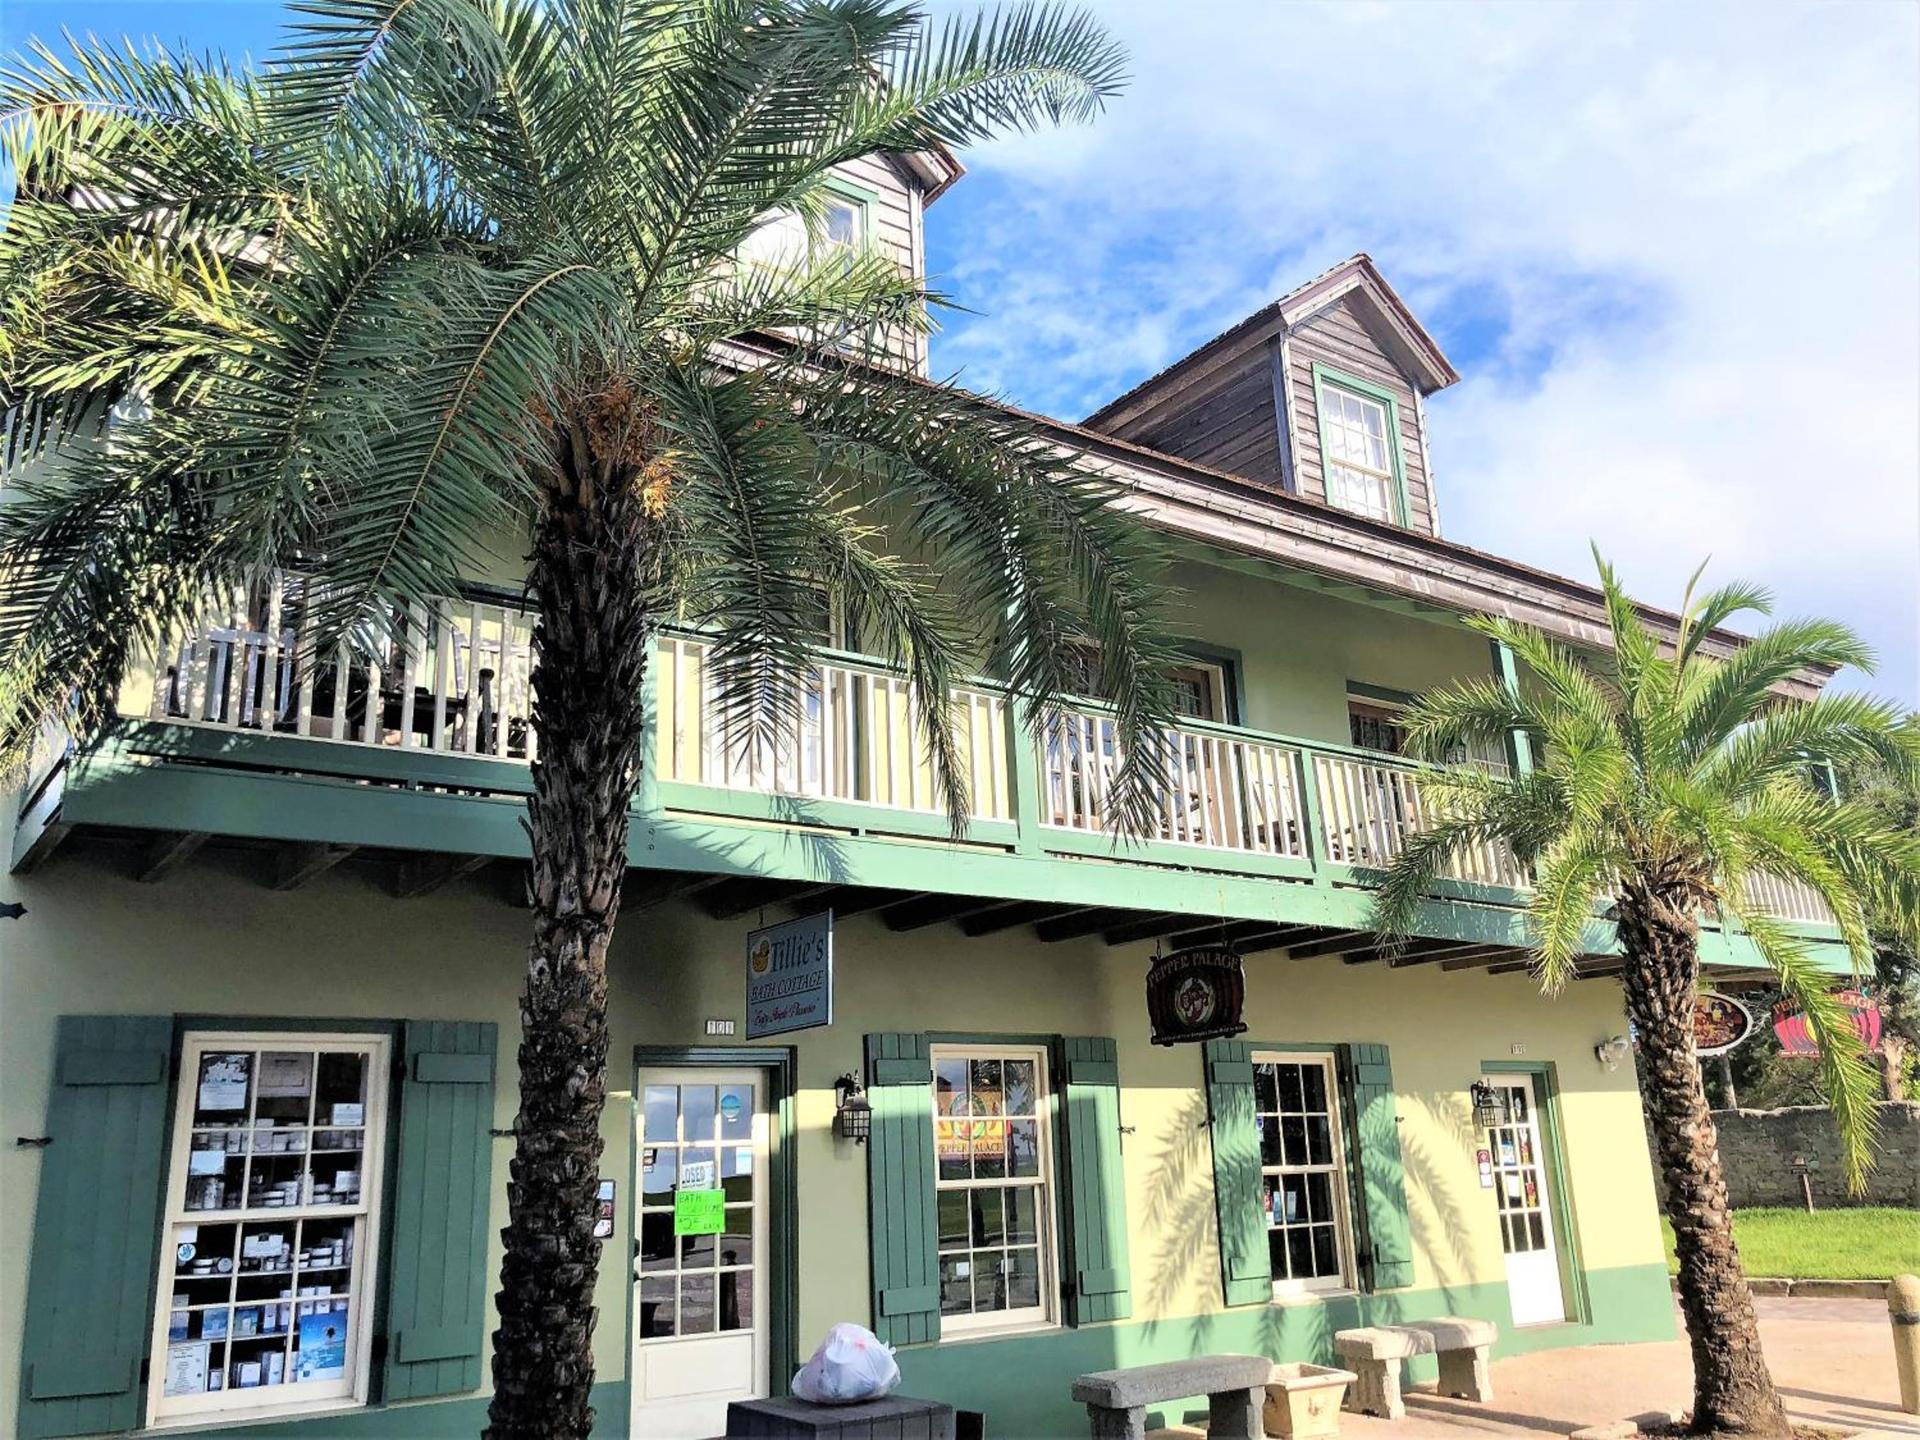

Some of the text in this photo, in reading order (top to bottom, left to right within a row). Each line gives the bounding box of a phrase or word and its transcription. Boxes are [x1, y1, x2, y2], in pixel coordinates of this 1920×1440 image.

[771, 932, 824, 972] Tillie's
[1192, 952, 1239, 972] PALACE
[778, 970, 824, 995] COTTAGE
[938, 1142, 1002, 1153] EPPER ALACE
[682, 1165, 706, 1184] OSED
